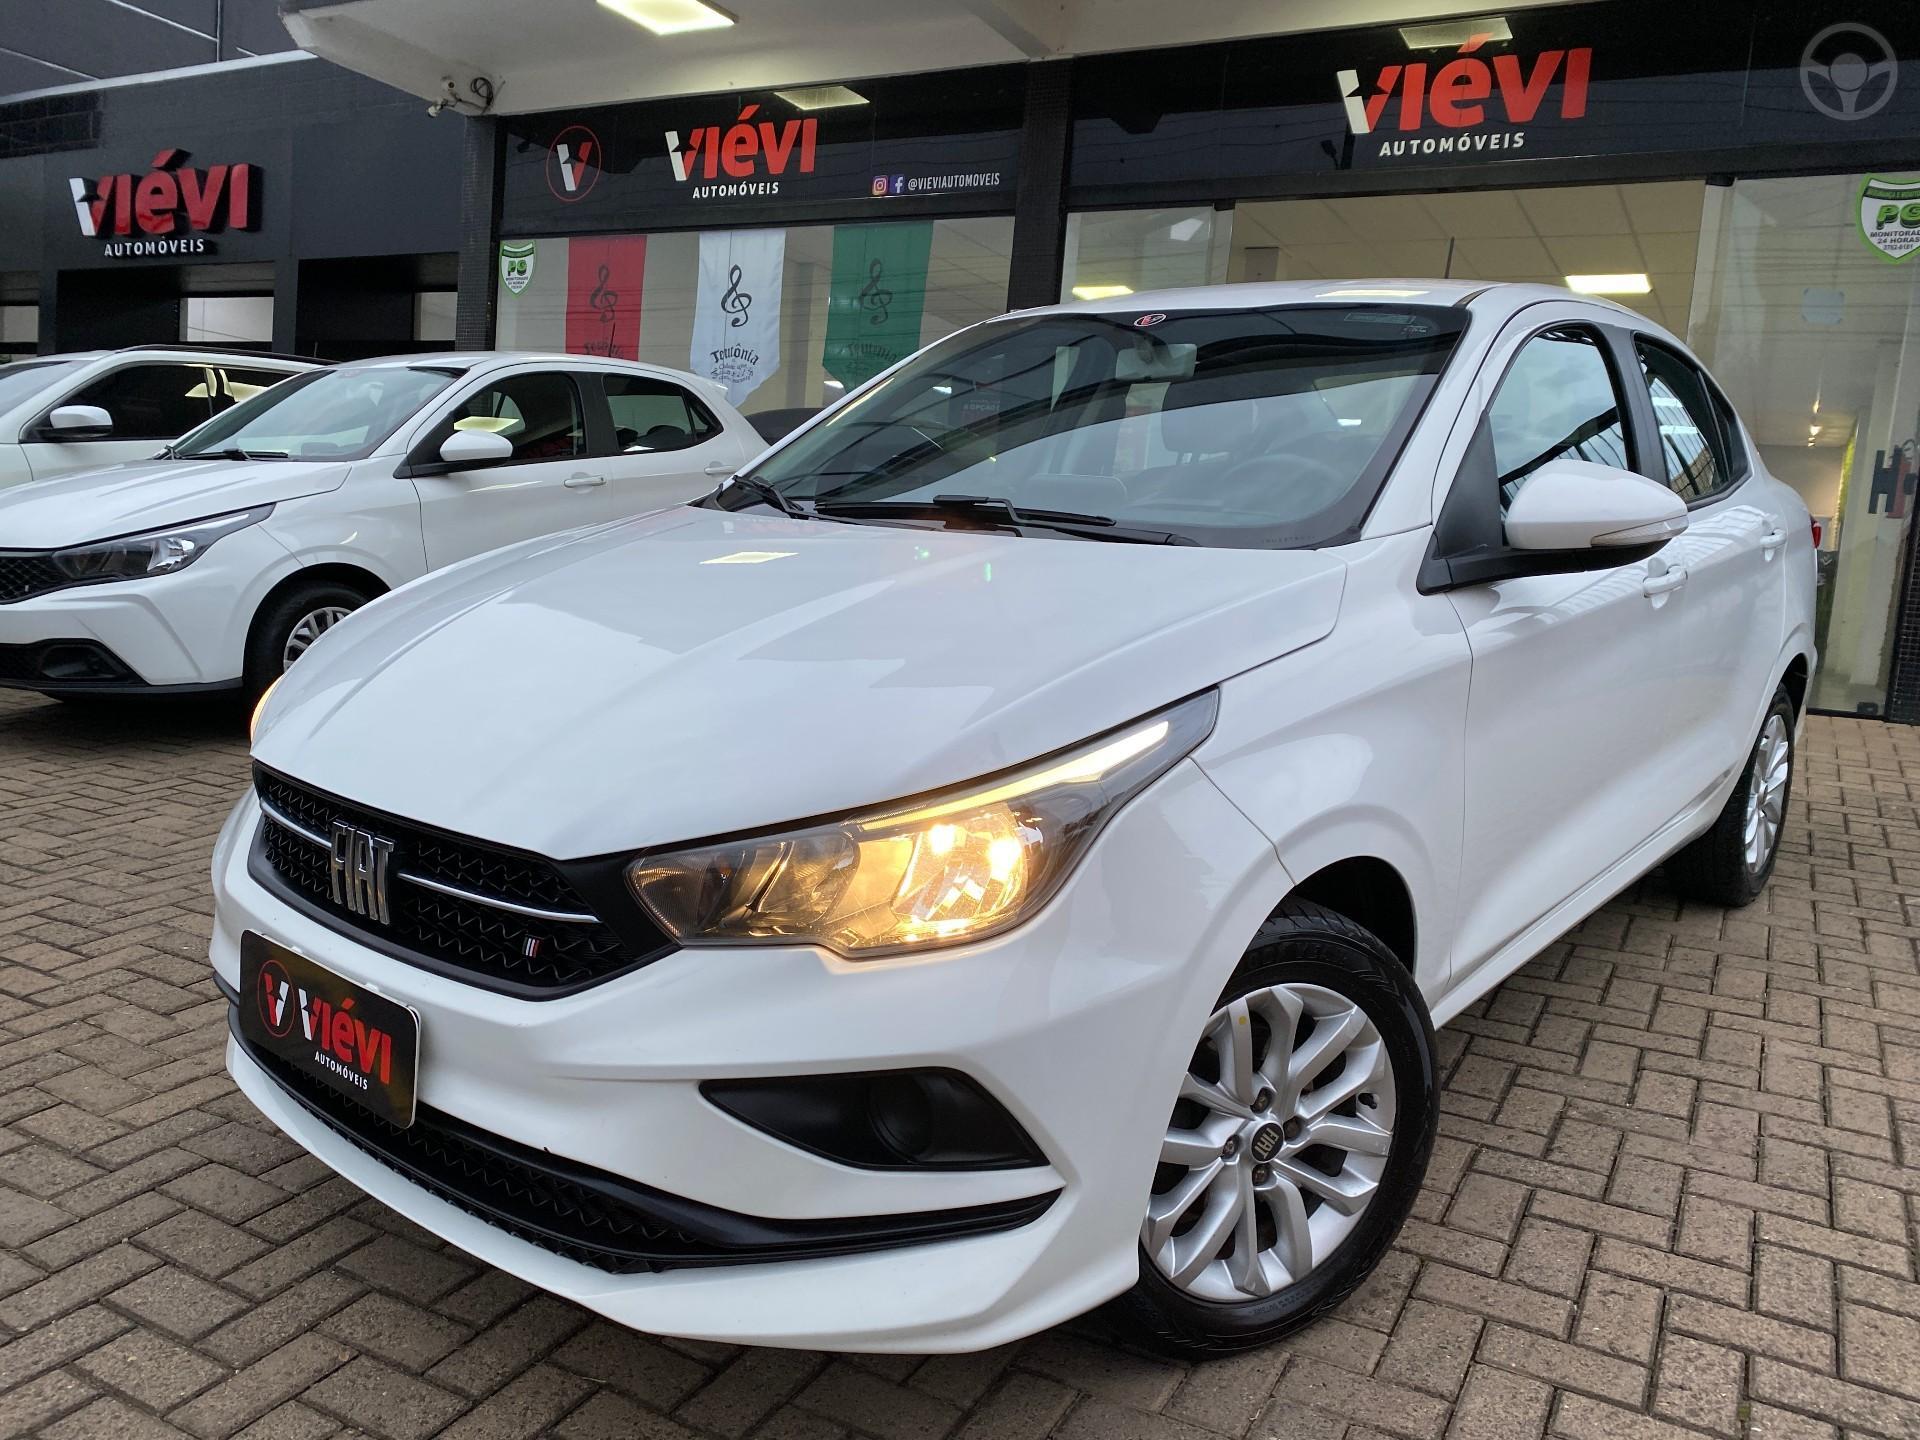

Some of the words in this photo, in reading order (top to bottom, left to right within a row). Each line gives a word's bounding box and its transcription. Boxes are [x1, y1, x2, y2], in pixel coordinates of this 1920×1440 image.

[1379, 132, 1525, 157] AUTOMÓVEIS
[692, 180, 780, 199] AUTOMÓVEIS
[907, 172, 1000, 191] @VIEVIAUTOMOVEIS
[104, 236, 205, 258] AUTOMÓVEIS
[1889, 236, 1920, 244] HORAS
[330, 819, 396, 926] FIAT
[314, 1050, 369, 1091] AUTOMÓVEIS
[1254, 1127, 1280, 1159] FIAT
